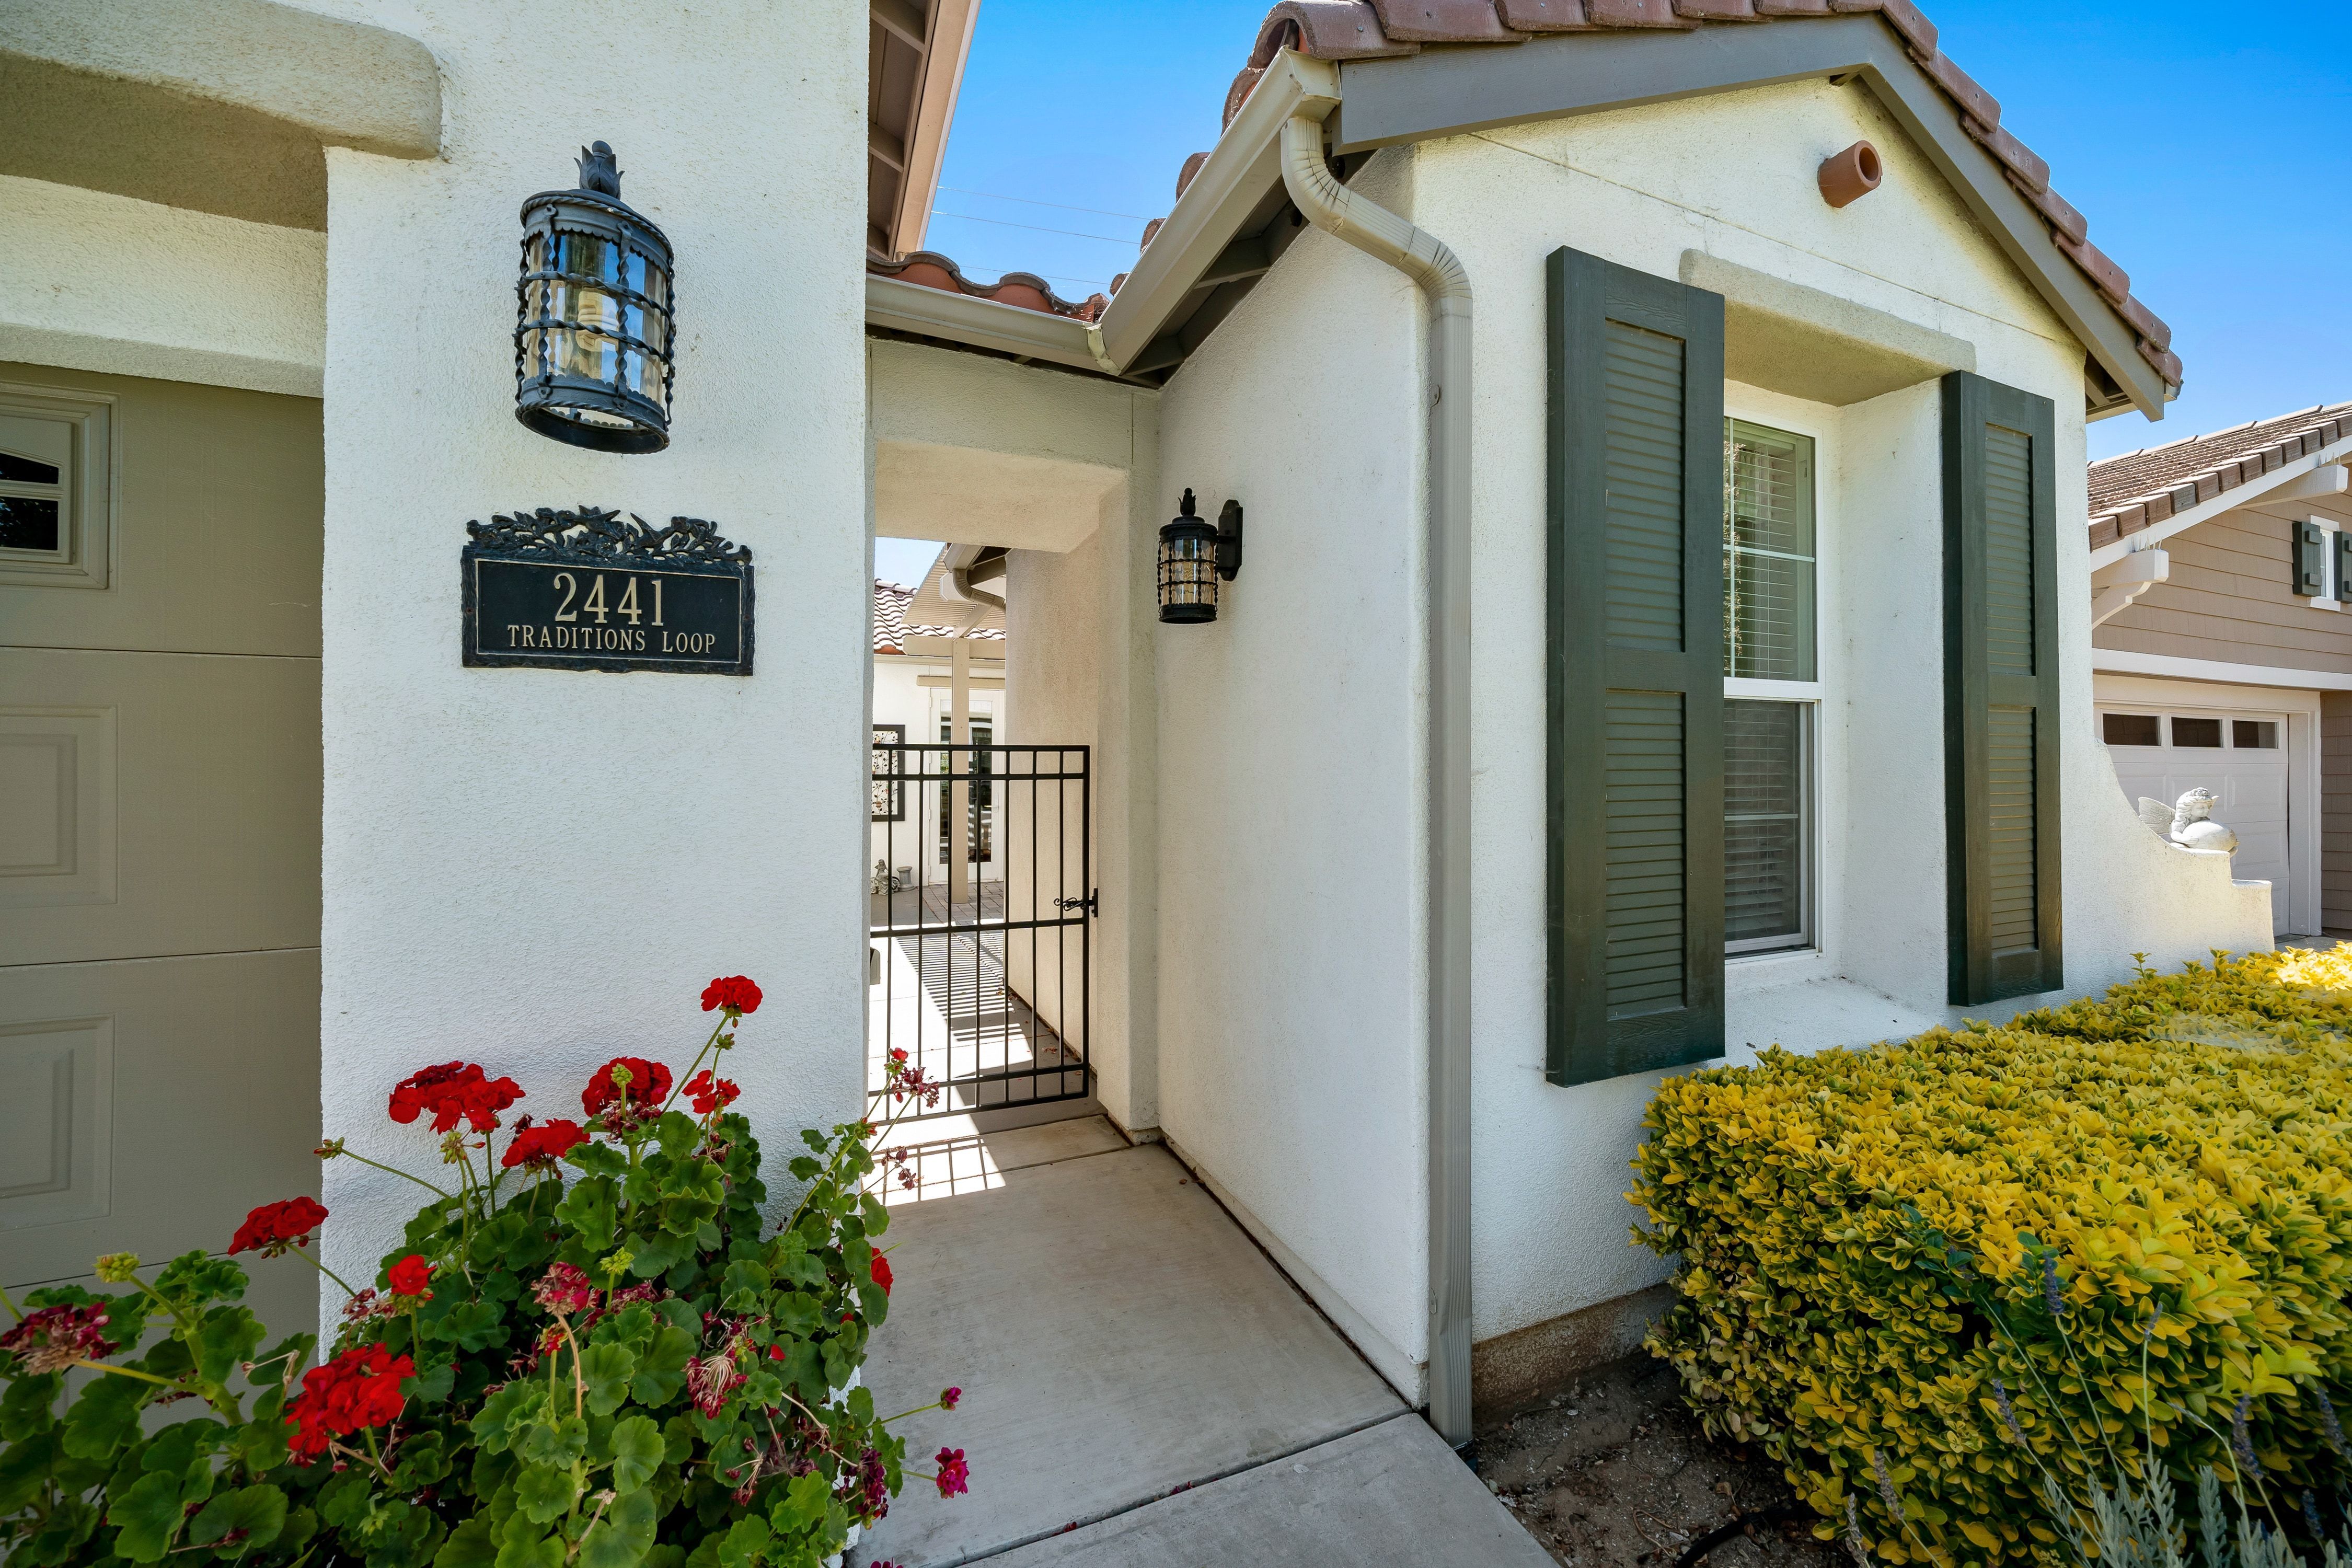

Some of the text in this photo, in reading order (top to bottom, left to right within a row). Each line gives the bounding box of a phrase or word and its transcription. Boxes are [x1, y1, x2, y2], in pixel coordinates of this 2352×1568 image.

[554, 573, 664, 626] 2441
[507, 625, 716, 653] TRADITIONS LOOP
